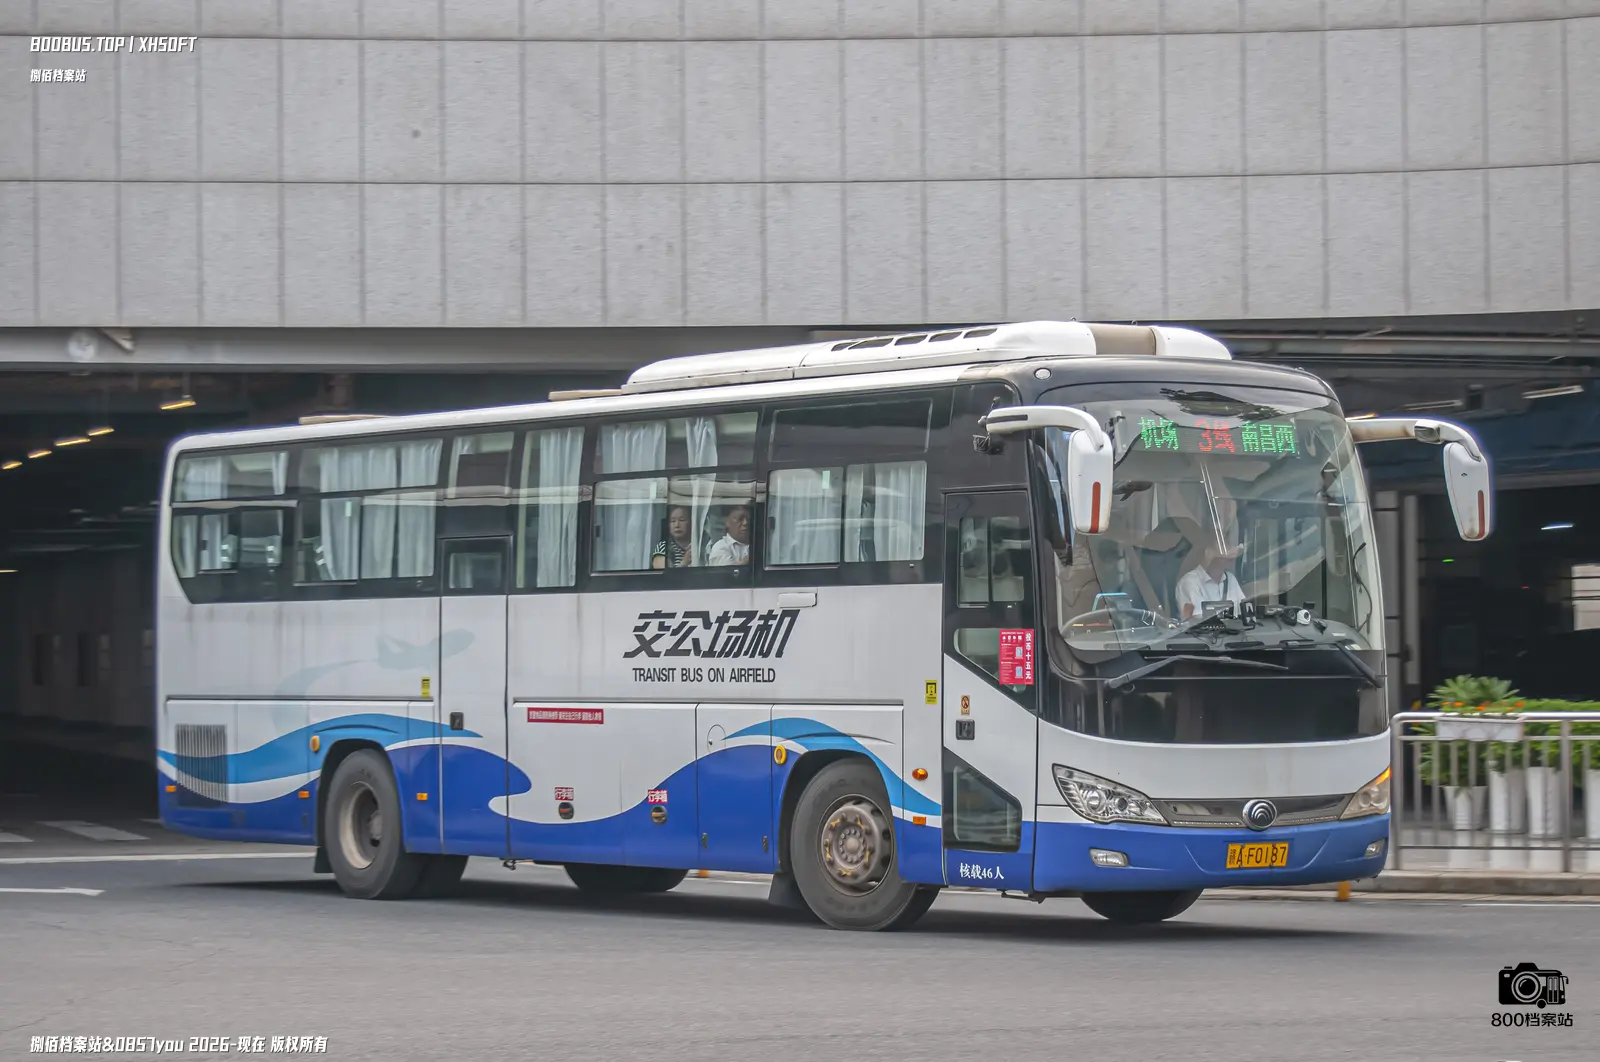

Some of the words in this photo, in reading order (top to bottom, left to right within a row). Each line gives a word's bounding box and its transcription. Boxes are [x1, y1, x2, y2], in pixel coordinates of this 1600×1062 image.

[1138, 416, 1179, 450] 机场
[1239, 420, 1296, 454] 南昌西
[632, 667, 676, 683] TRANSIT
[681, 667, 703, 683] BUS
[708, 667, 725, 683] ON
[729, 667, 776, 683] AIRFIELD
[959, 862, 1005, 880] 核载46人
